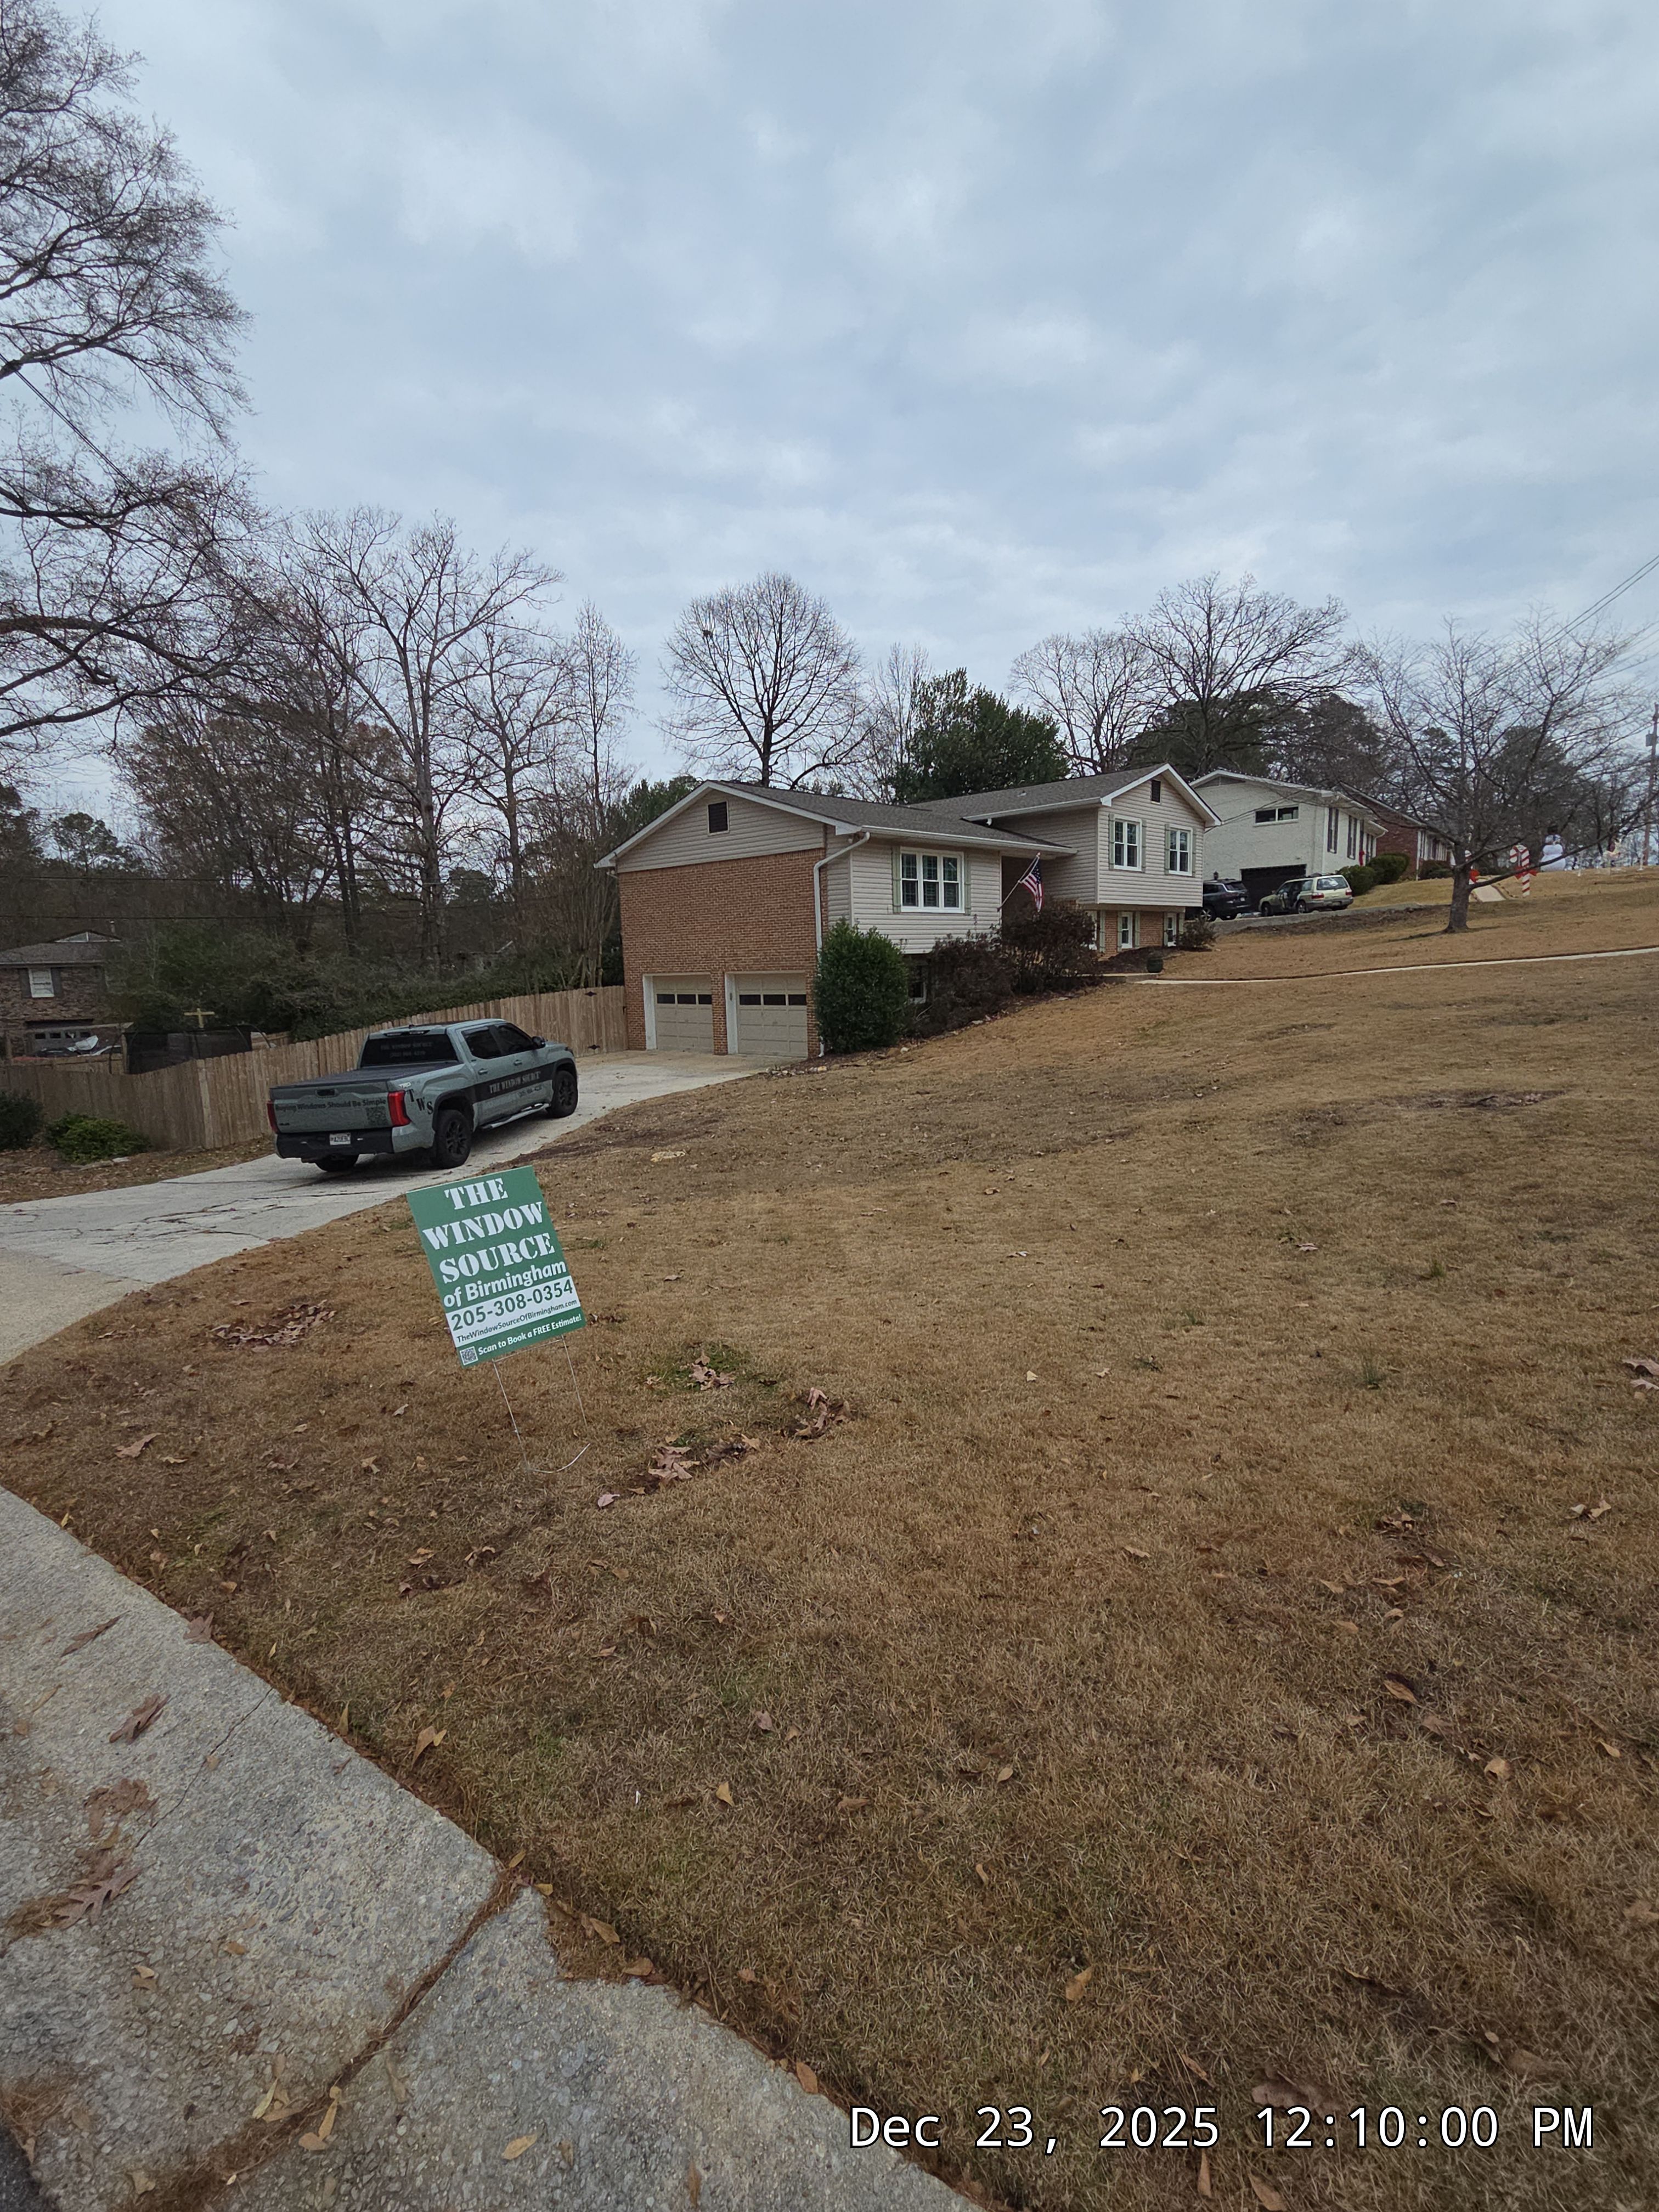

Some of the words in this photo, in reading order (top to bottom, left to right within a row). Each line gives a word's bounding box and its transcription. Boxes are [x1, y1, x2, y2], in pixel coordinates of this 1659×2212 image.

[363, 1098, 387, 1107] Simple
[443, 1177, 509, 1210] THE
[422, 1201, 543, 1250] WINDOW
[439, 1232, 555, 1284] SOURCE
[443, 1286, 462, 1307] of
[465, 1261, 567, 1301] Birmingham
[451, 1279, 573, 1331] 205-308-0354
[456, 1299, 577, 1344] TheWindowSourceOfBirmingham.com
[478, 1344, 497, 1356] Scan
[498, 1339, 507, 1347] to
[507, 1333, 527, 1345] Book
[533, 1323, 551, 1336] FREE
[551, 1313, 582, 1329] Estimate!
